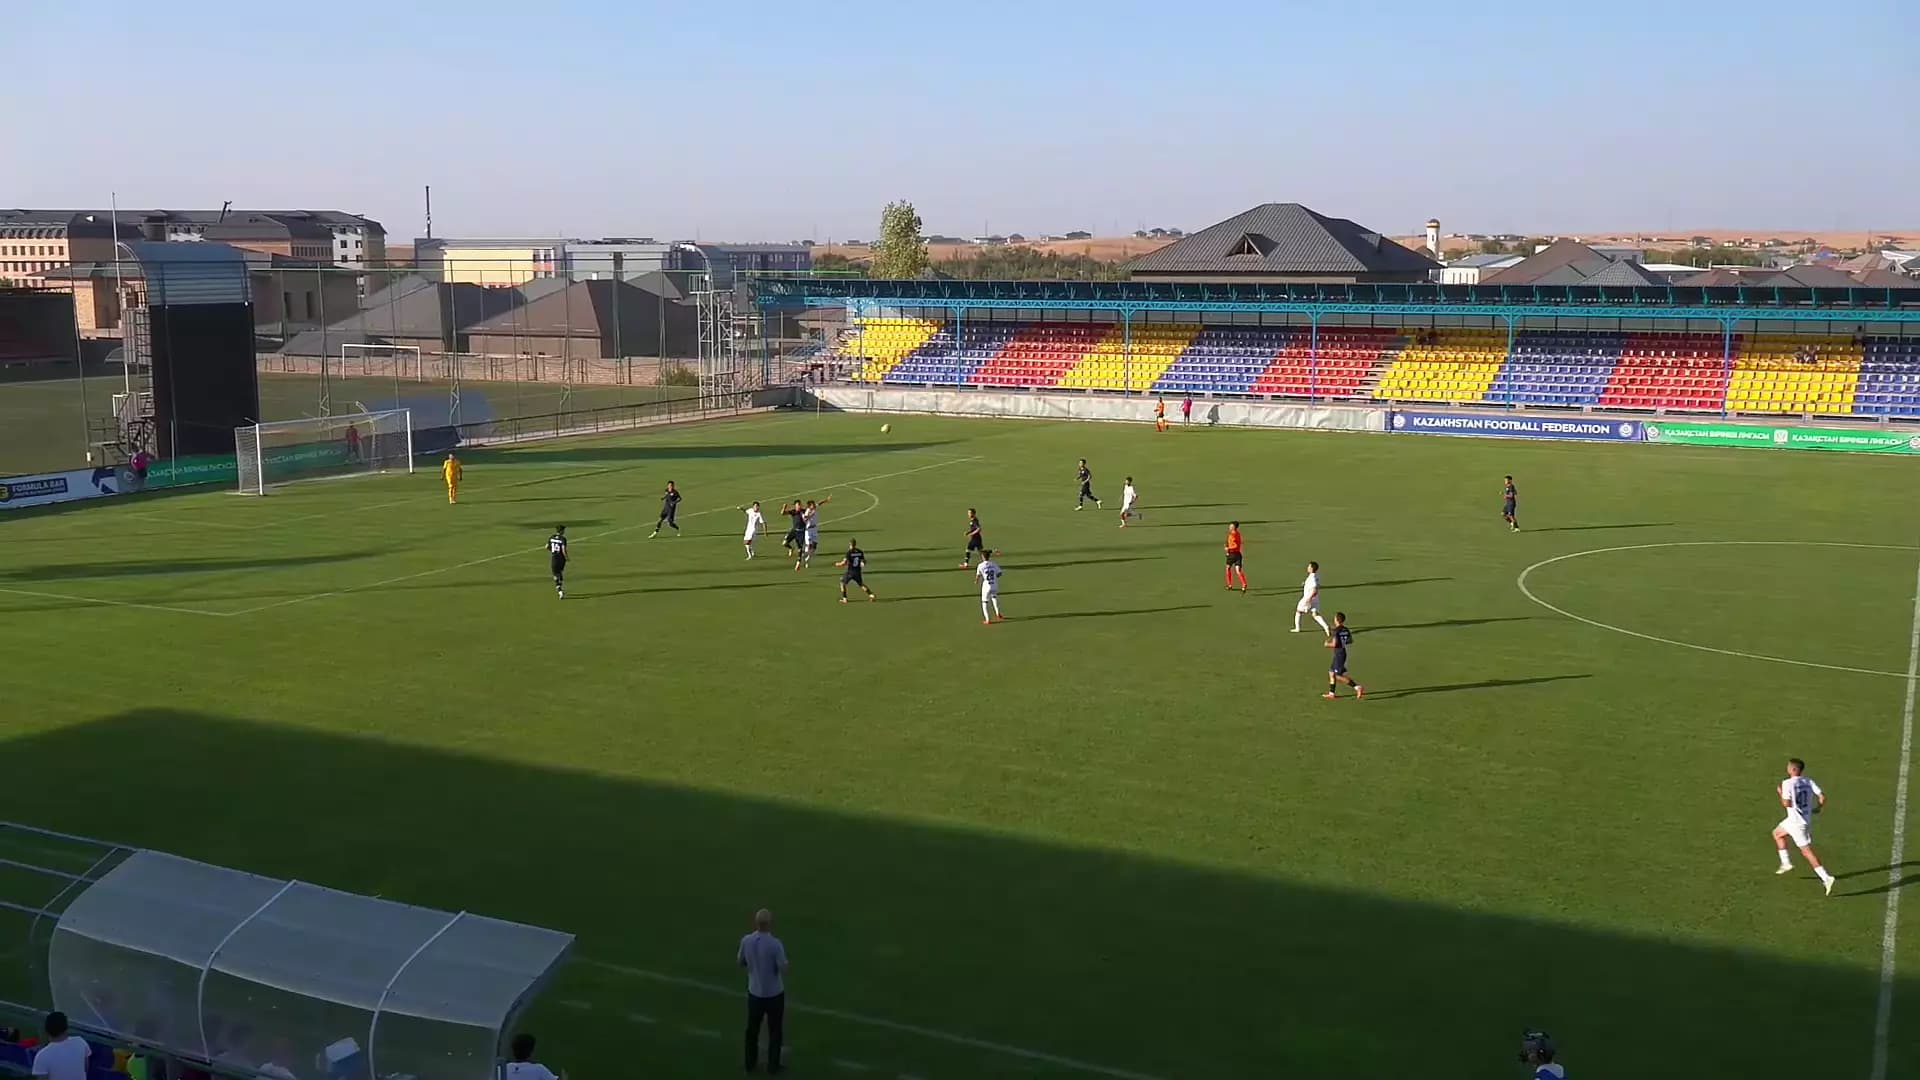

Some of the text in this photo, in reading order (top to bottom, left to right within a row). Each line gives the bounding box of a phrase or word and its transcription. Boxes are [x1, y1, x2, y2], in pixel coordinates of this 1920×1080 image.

[1413, 417, 1610, 434] KAZAKHSTAN FOOTBALL FEDERATION
[12, 481, 49, 493] FORMULA
[50, 479, 65, 489] BAR
